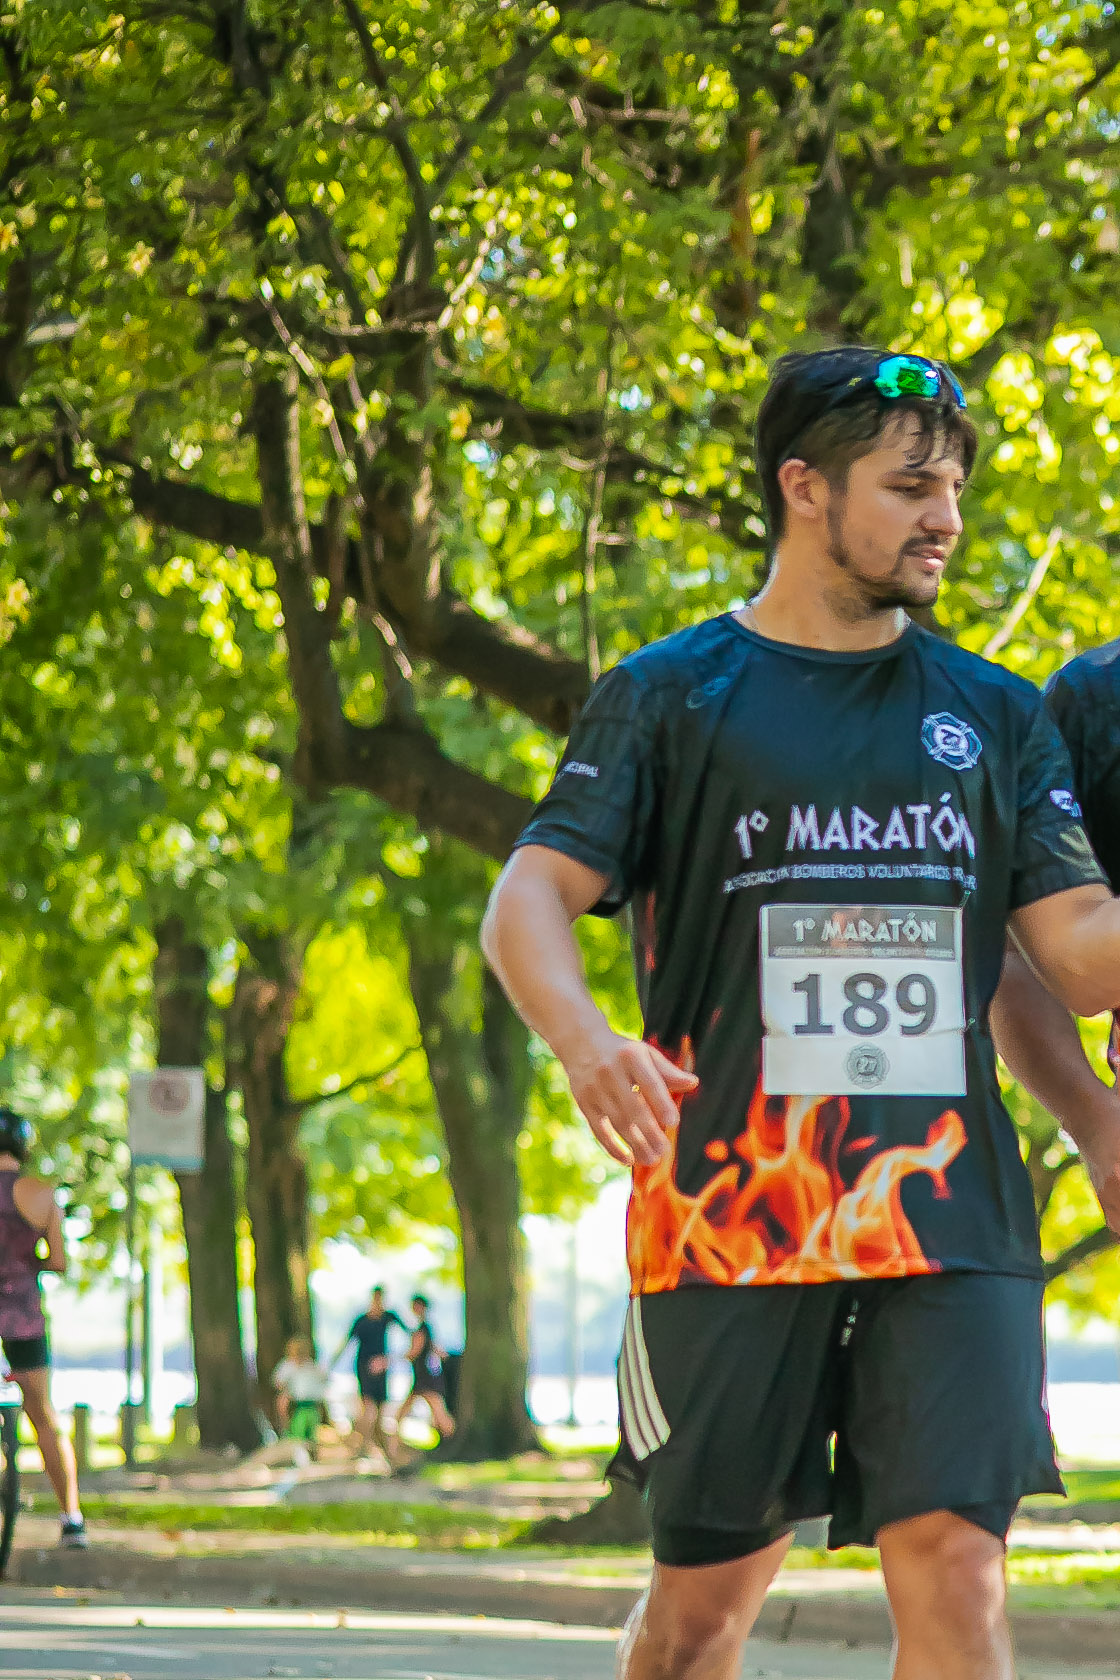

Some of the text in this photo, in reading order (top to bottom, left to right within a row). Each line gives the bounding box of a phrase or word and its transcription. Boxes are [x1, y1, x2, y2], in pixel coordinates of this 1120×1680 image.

[785, 791, 977, 860] MARATÓN
[820, 911, 938, 942] MARATÓN
[792, 972, 937, 1036] 189
